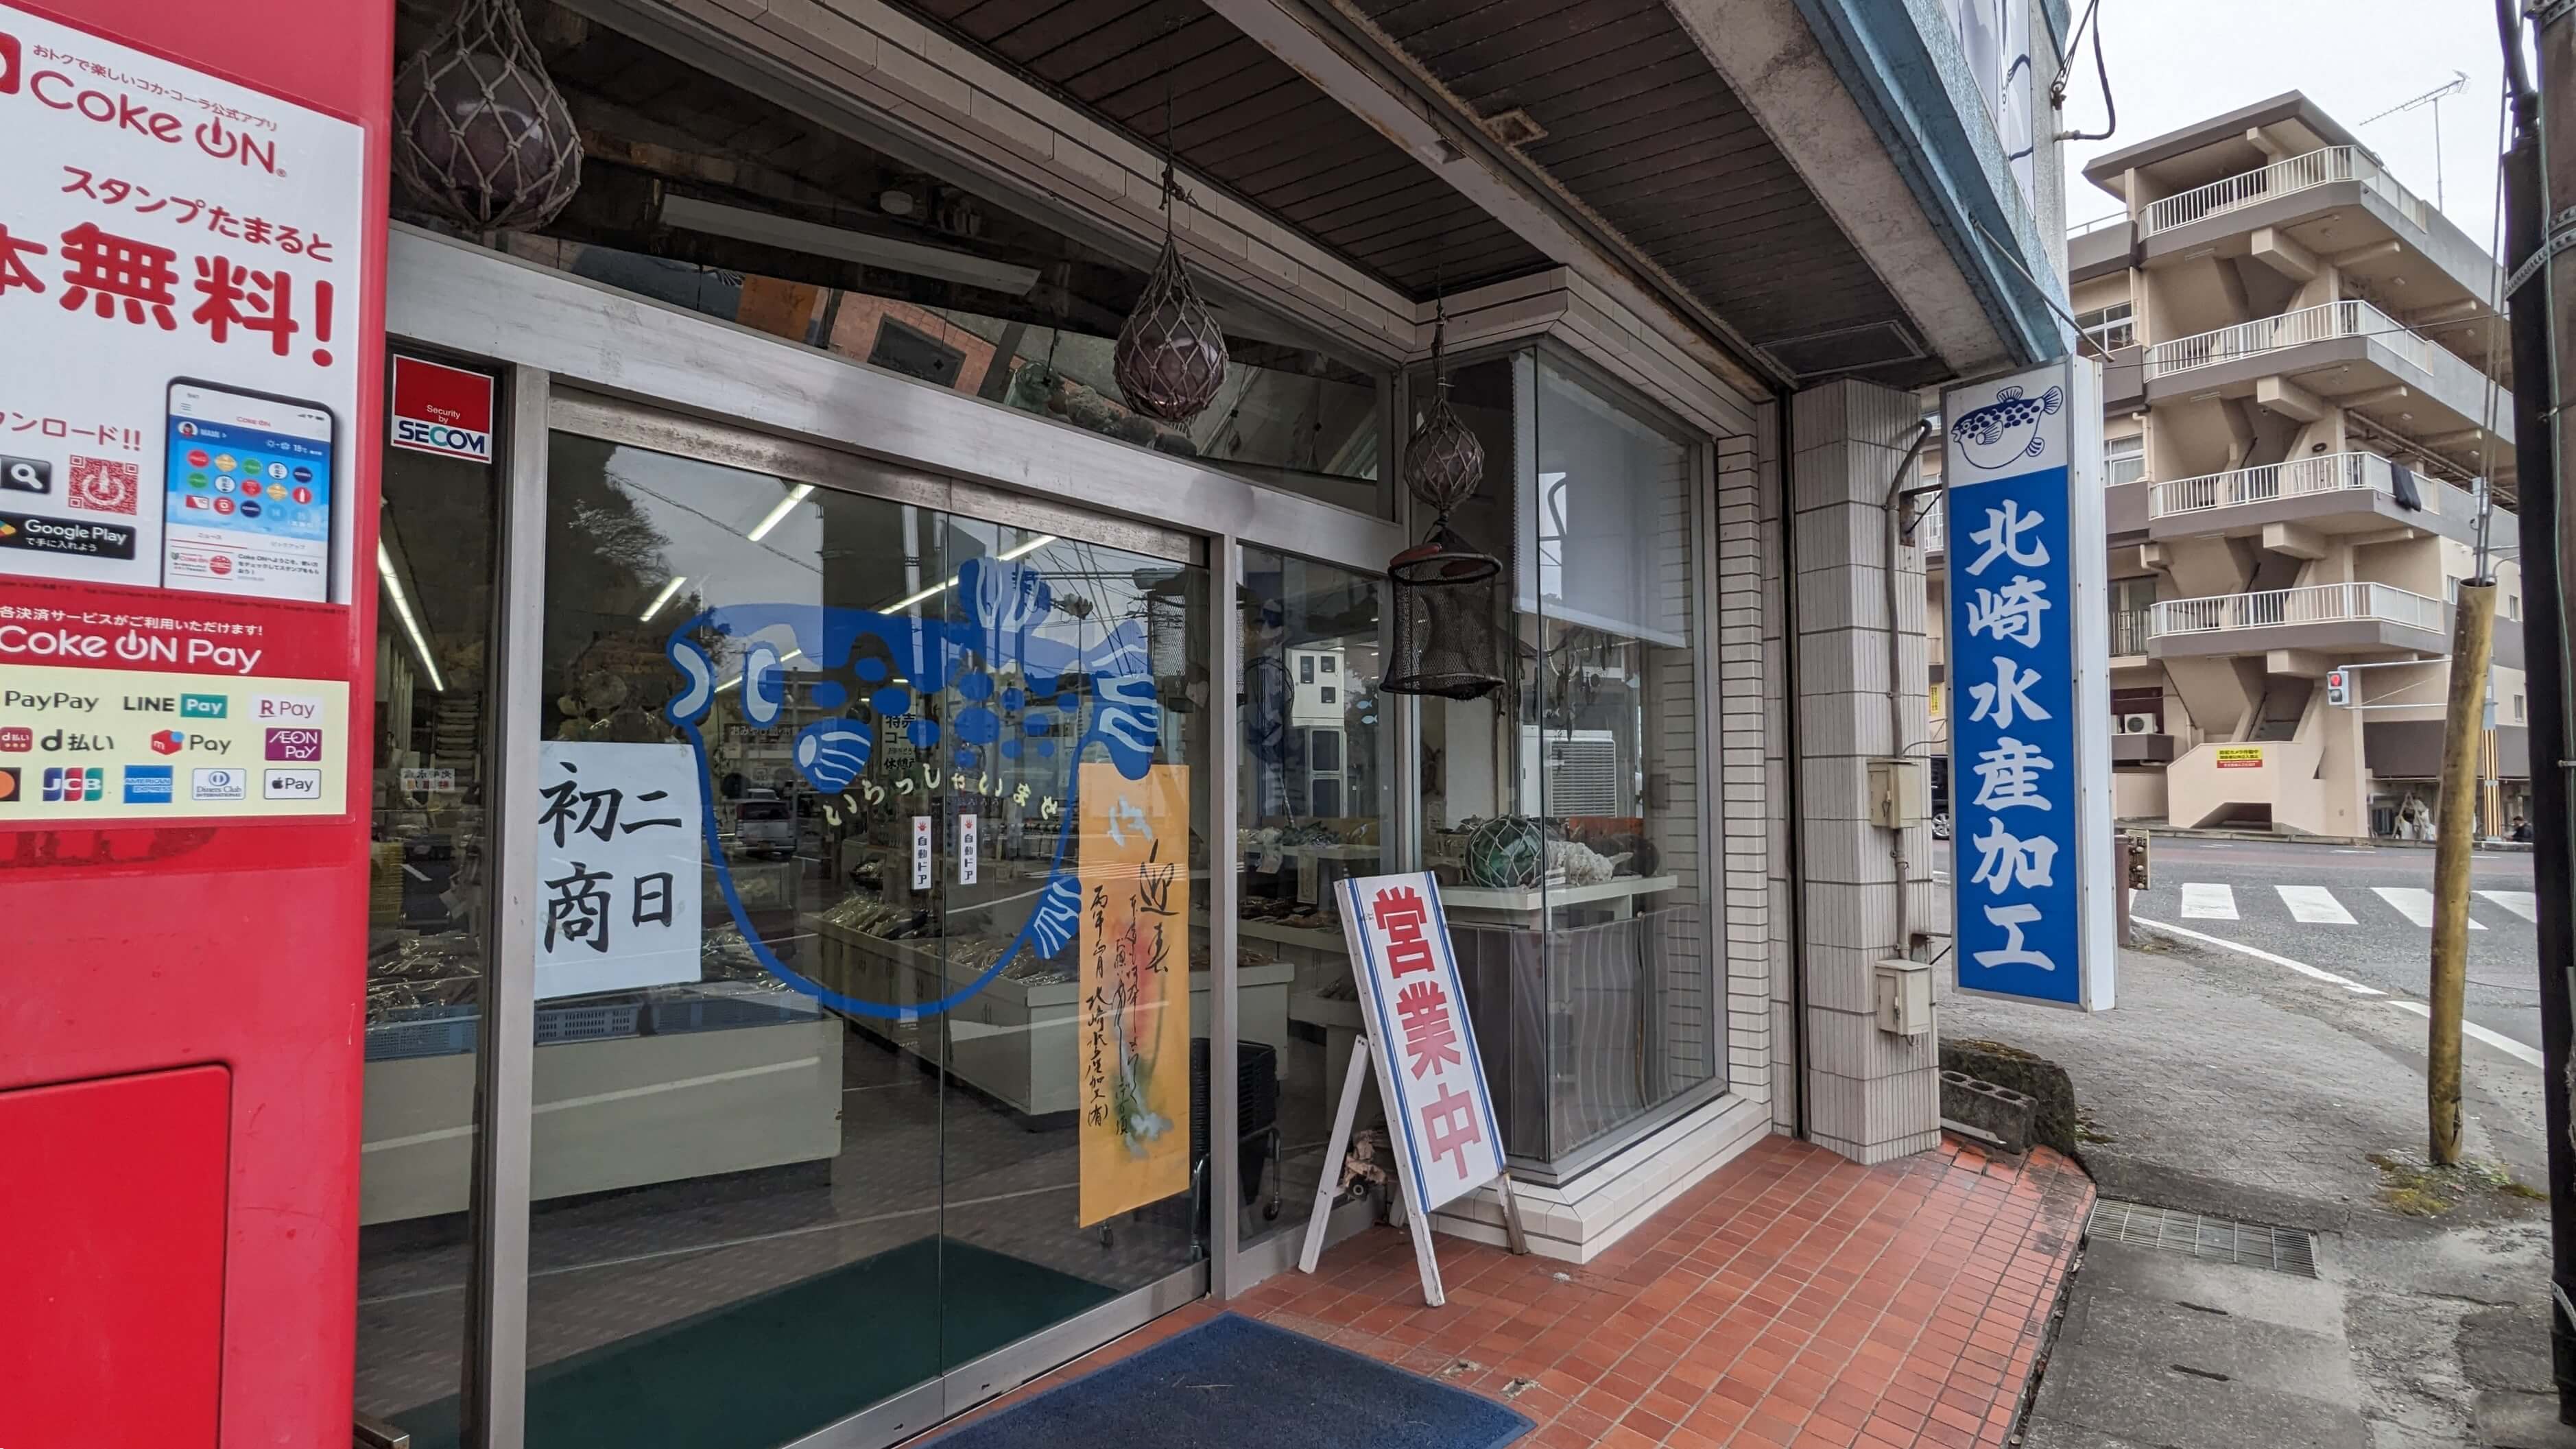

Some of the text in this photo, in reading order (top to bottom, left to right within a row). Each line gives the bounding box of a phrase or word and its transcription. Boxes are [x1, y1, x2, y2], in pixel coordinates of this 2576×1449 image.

[34, 45, 277, 132] おトクで楽しいコカ・コーラ公式アプリ
[30, 70, 183, 143] Coke
[62, 165, 333, 263] スタンプたまると
[427, 405, 461, 420] Security
[438, 415, 449, 424] by
[0, 411, 141, 451] ンロード!!
[398, 420, 485, 454] SECOM
[25, 519, 128, 545] Google Play
[25, 537, 97, 551] で手に入れよう
[0, 606, 263, 636] 各決済サービスがご利用いただけます!
[0, 625, 108, 658] Coke
[187, 638, 262, 673] Pay
[5, 690, 99, 712] PayPay
[123, 696, 223, 715] LINE Pay
[280, 701, 315, 719] Pay
[40, 729, 115, 752] d払い
[190, 734, 232, 755] Pay
[1965, 499, 2058, 971] 北崎水産加工
[43, 778, 102, 791] JCB
[285, 778, 314, 792] Pay
[918, 836, 927, 885] 自動ドア
[964, 833, 973, 881] 自動ドア
[1373, 885, 1481, 1180] 営業中
